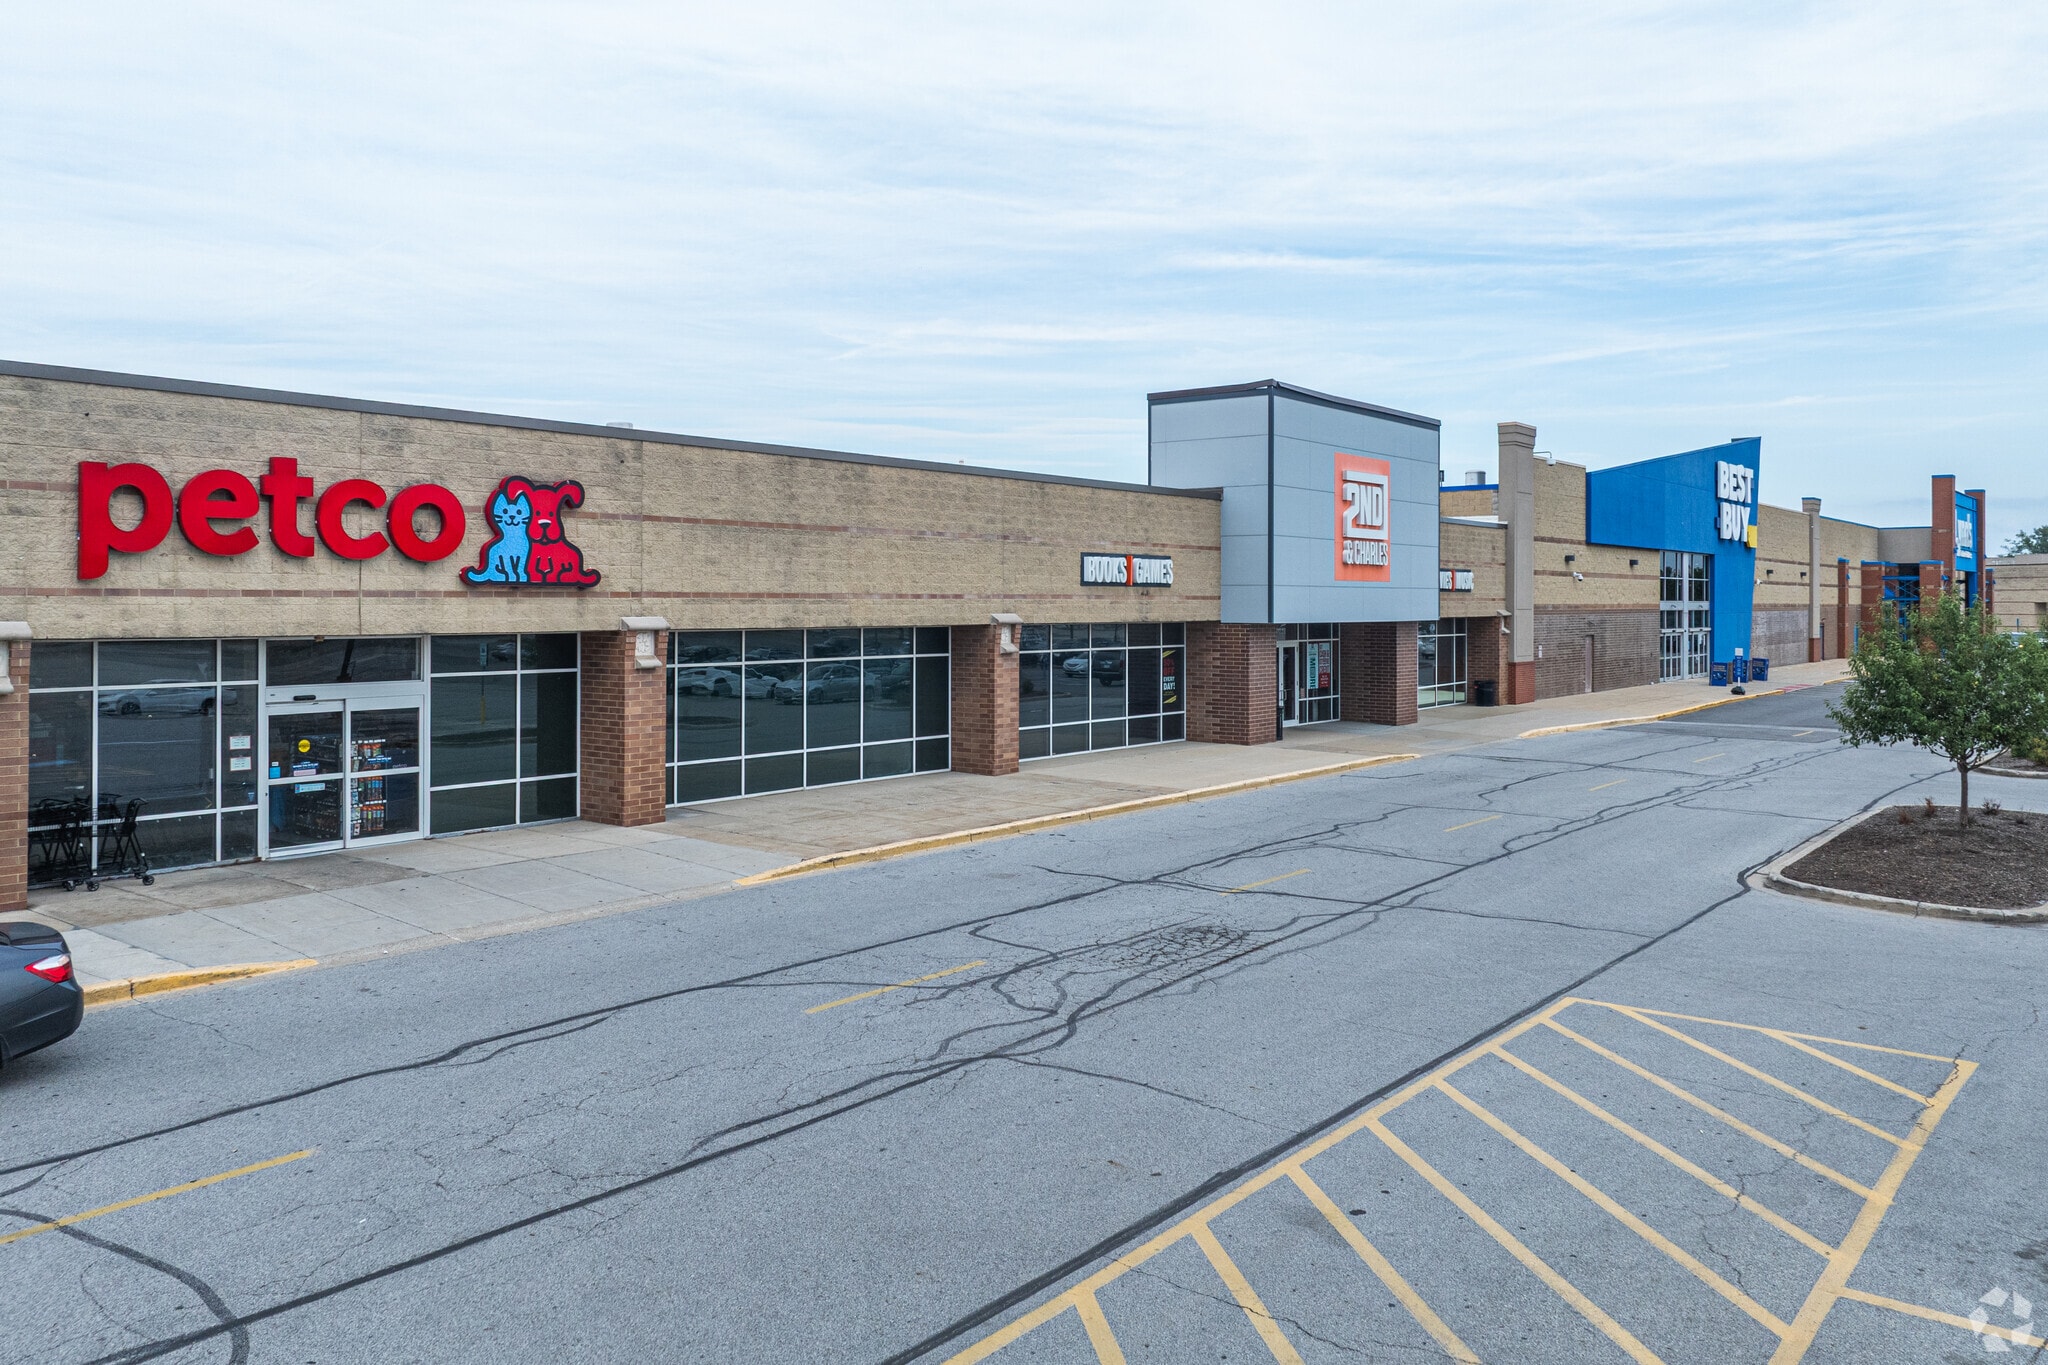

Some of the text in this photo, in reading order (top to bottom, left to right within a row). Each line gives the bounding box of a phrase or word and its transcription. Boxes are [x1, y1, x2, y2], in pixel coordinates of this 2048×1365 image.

[1717, 460, 1754, 504] BEST
[77, 456, 466, 580] petco
[1342, 481, 1384, 538] 2ND
[1720, 501, 1751, 543] BUY
[1083, 556, 1174, 585] BOOKS GAMES
[1342, 540, 1388, 566] & CHARLES
[1163, 682, 1176, 690] DAY!
